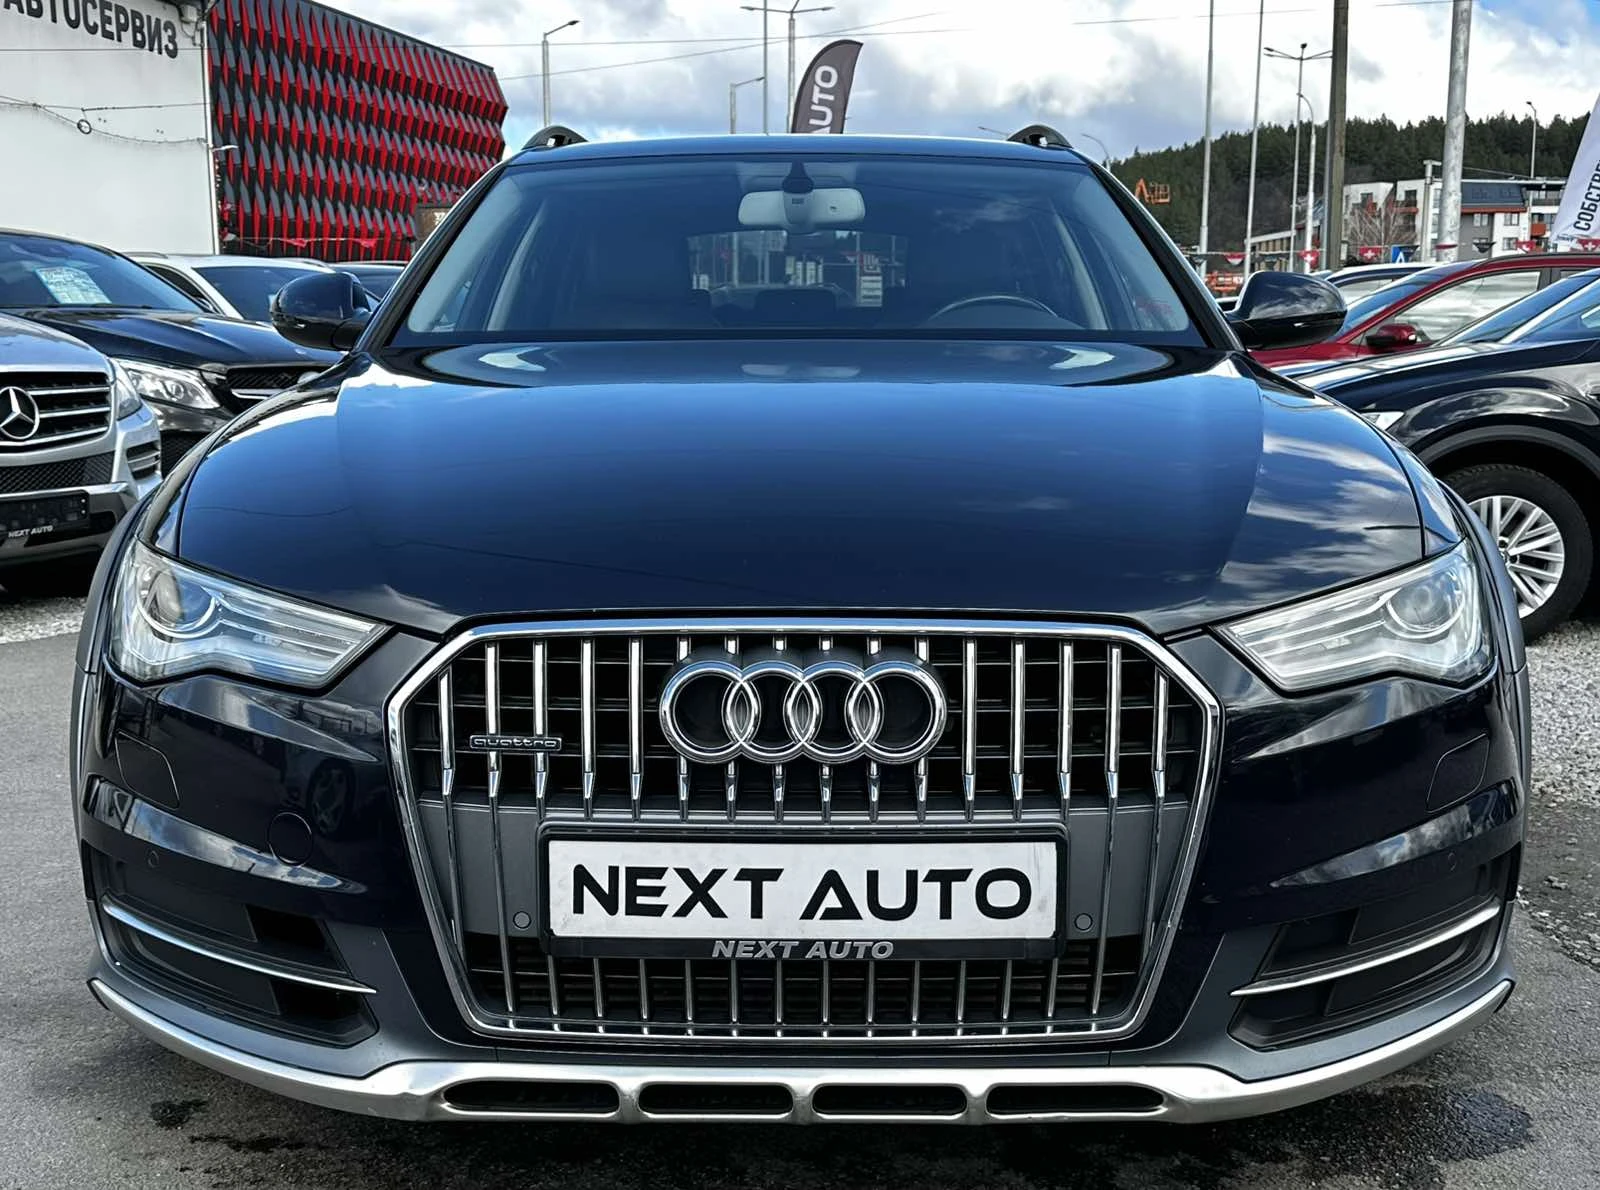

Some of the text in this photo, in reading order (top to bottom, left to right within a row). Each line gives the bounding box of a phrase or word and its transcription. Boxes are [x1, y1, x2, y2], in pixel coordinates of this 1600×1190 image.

[808, 65, 838, 134] UTO
[8, 525, 54, 538] NEXT AUTO
[474, 738, 557, 747] quattro
[572, 864, 1032, 922] NEXT AUTO
[711, 940, 894, 959] NEXT AUTO
